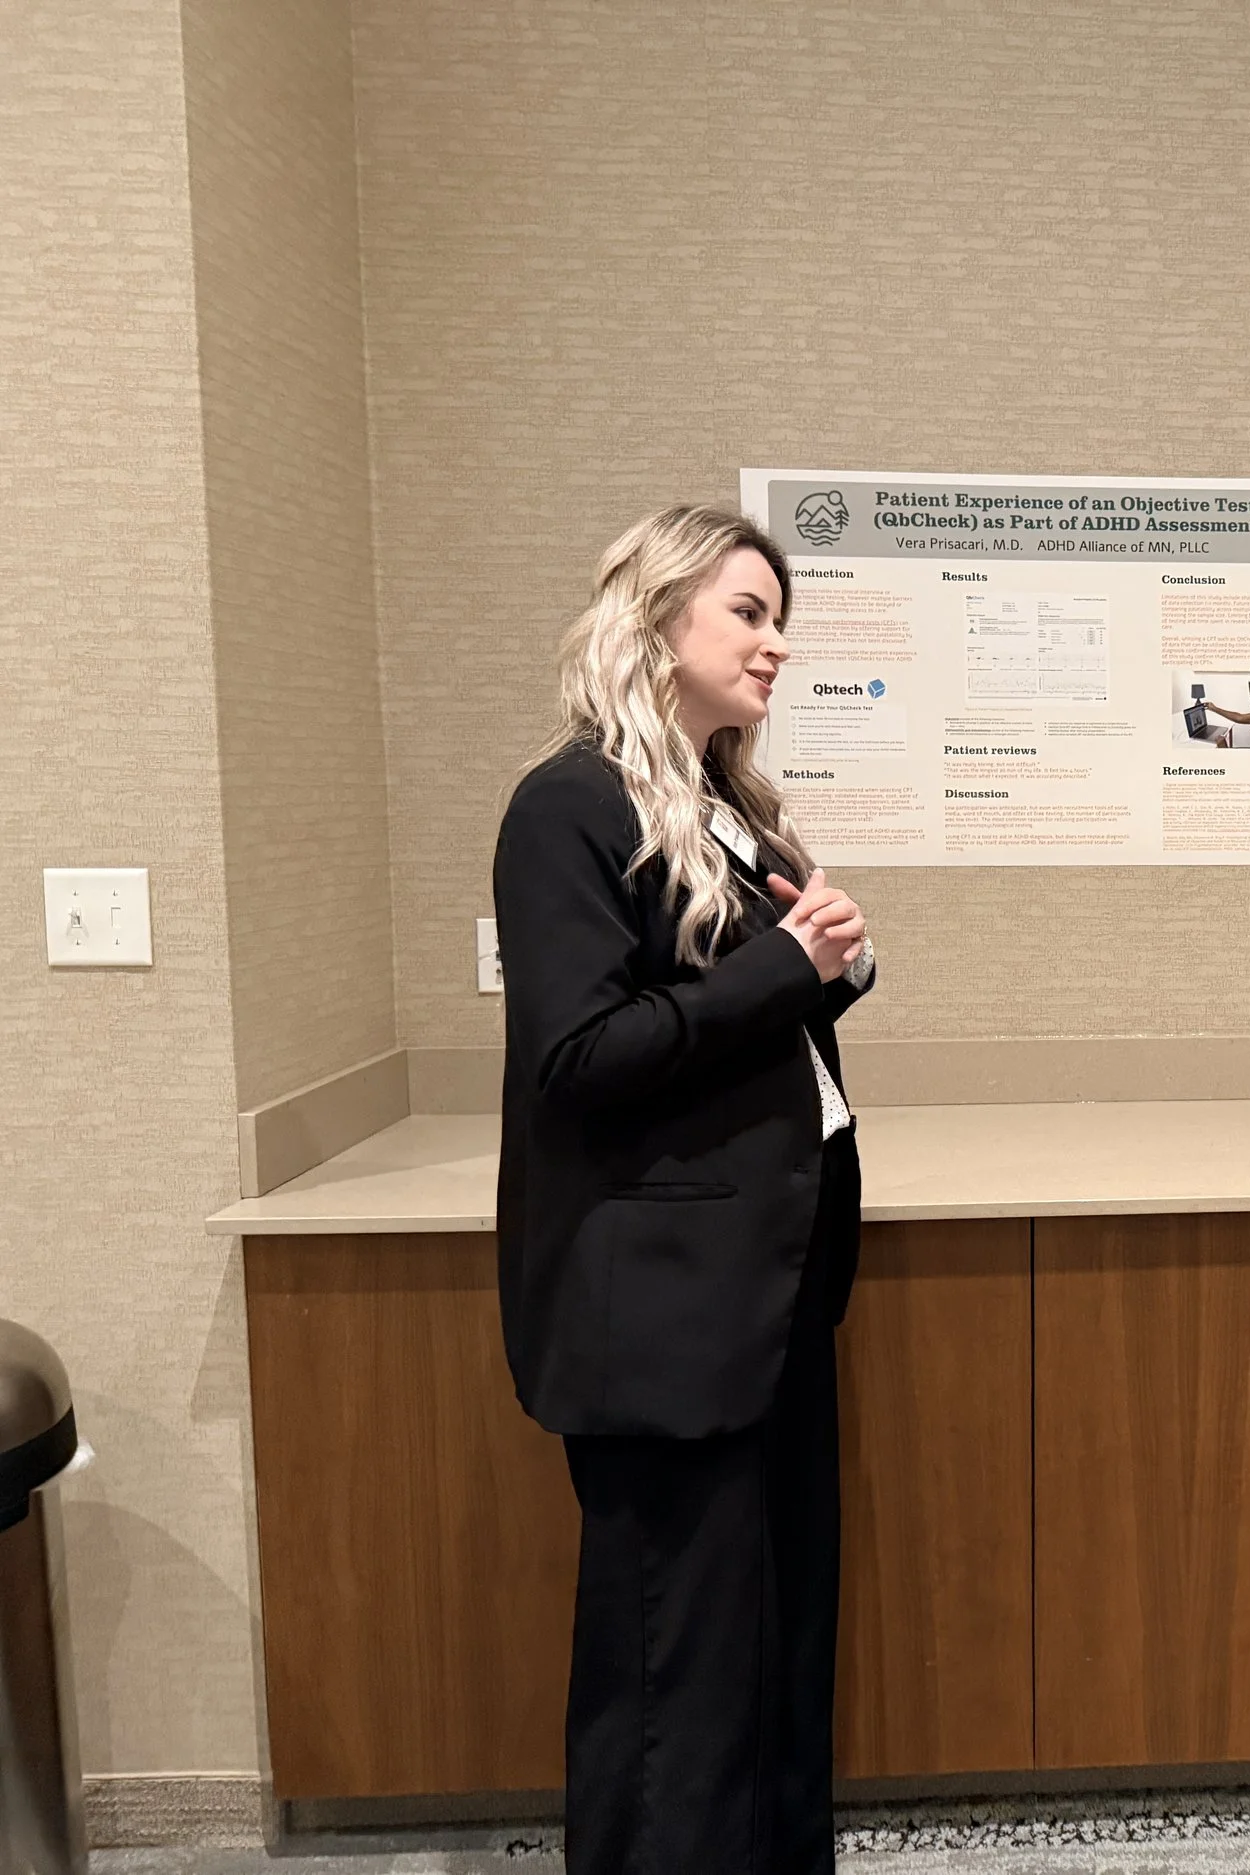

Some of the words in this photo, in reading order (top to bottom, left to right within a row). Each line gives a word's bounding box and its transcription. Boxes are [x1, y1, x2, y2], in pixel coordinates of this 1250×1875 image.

[876, 491, 949, 506] Patient
[955, 493, 1063, 511] Experience
[1069, 496, 1088, 510] of
[1092, 499, 1115, 511] an
[1121, 496, 1210, 514] Objective
[874, 512, 977, 531] (QbCheck)
[983, 518, 1004, 529] as
[1010, 515, 1053, 530] Part
[1059, 516, 1078, 530] of
[1081, 516, 1140, 531] ADHD
[896, 538, 926, 549] Vera
[930, 538, 988, 551] Prisacari,
[993, 539, 1023, 551] M.D.
[1038, 539, 1075, 551] ADHD
[1079, 541, 1127, 552] Alliance
[1131, 541, 1144, 552] of
[1149, 542, 1175, 555] MN,
[1180, 542, 1209, 553] PLLC
[790, 569, 854, 578] troduction
[942, 572, 988, 581] Results
[1162, 575, 1226, 584] Conclusion
[813, 684, 863, 696] Qbtech
[944, 746, 988, 755] Patient
[992, 746, 1037, 755] reviews
[782, 770, 835, 779] Methods
[1163, 767, 1226, 776] References
[945, 789, 1009, 798] Discussion
